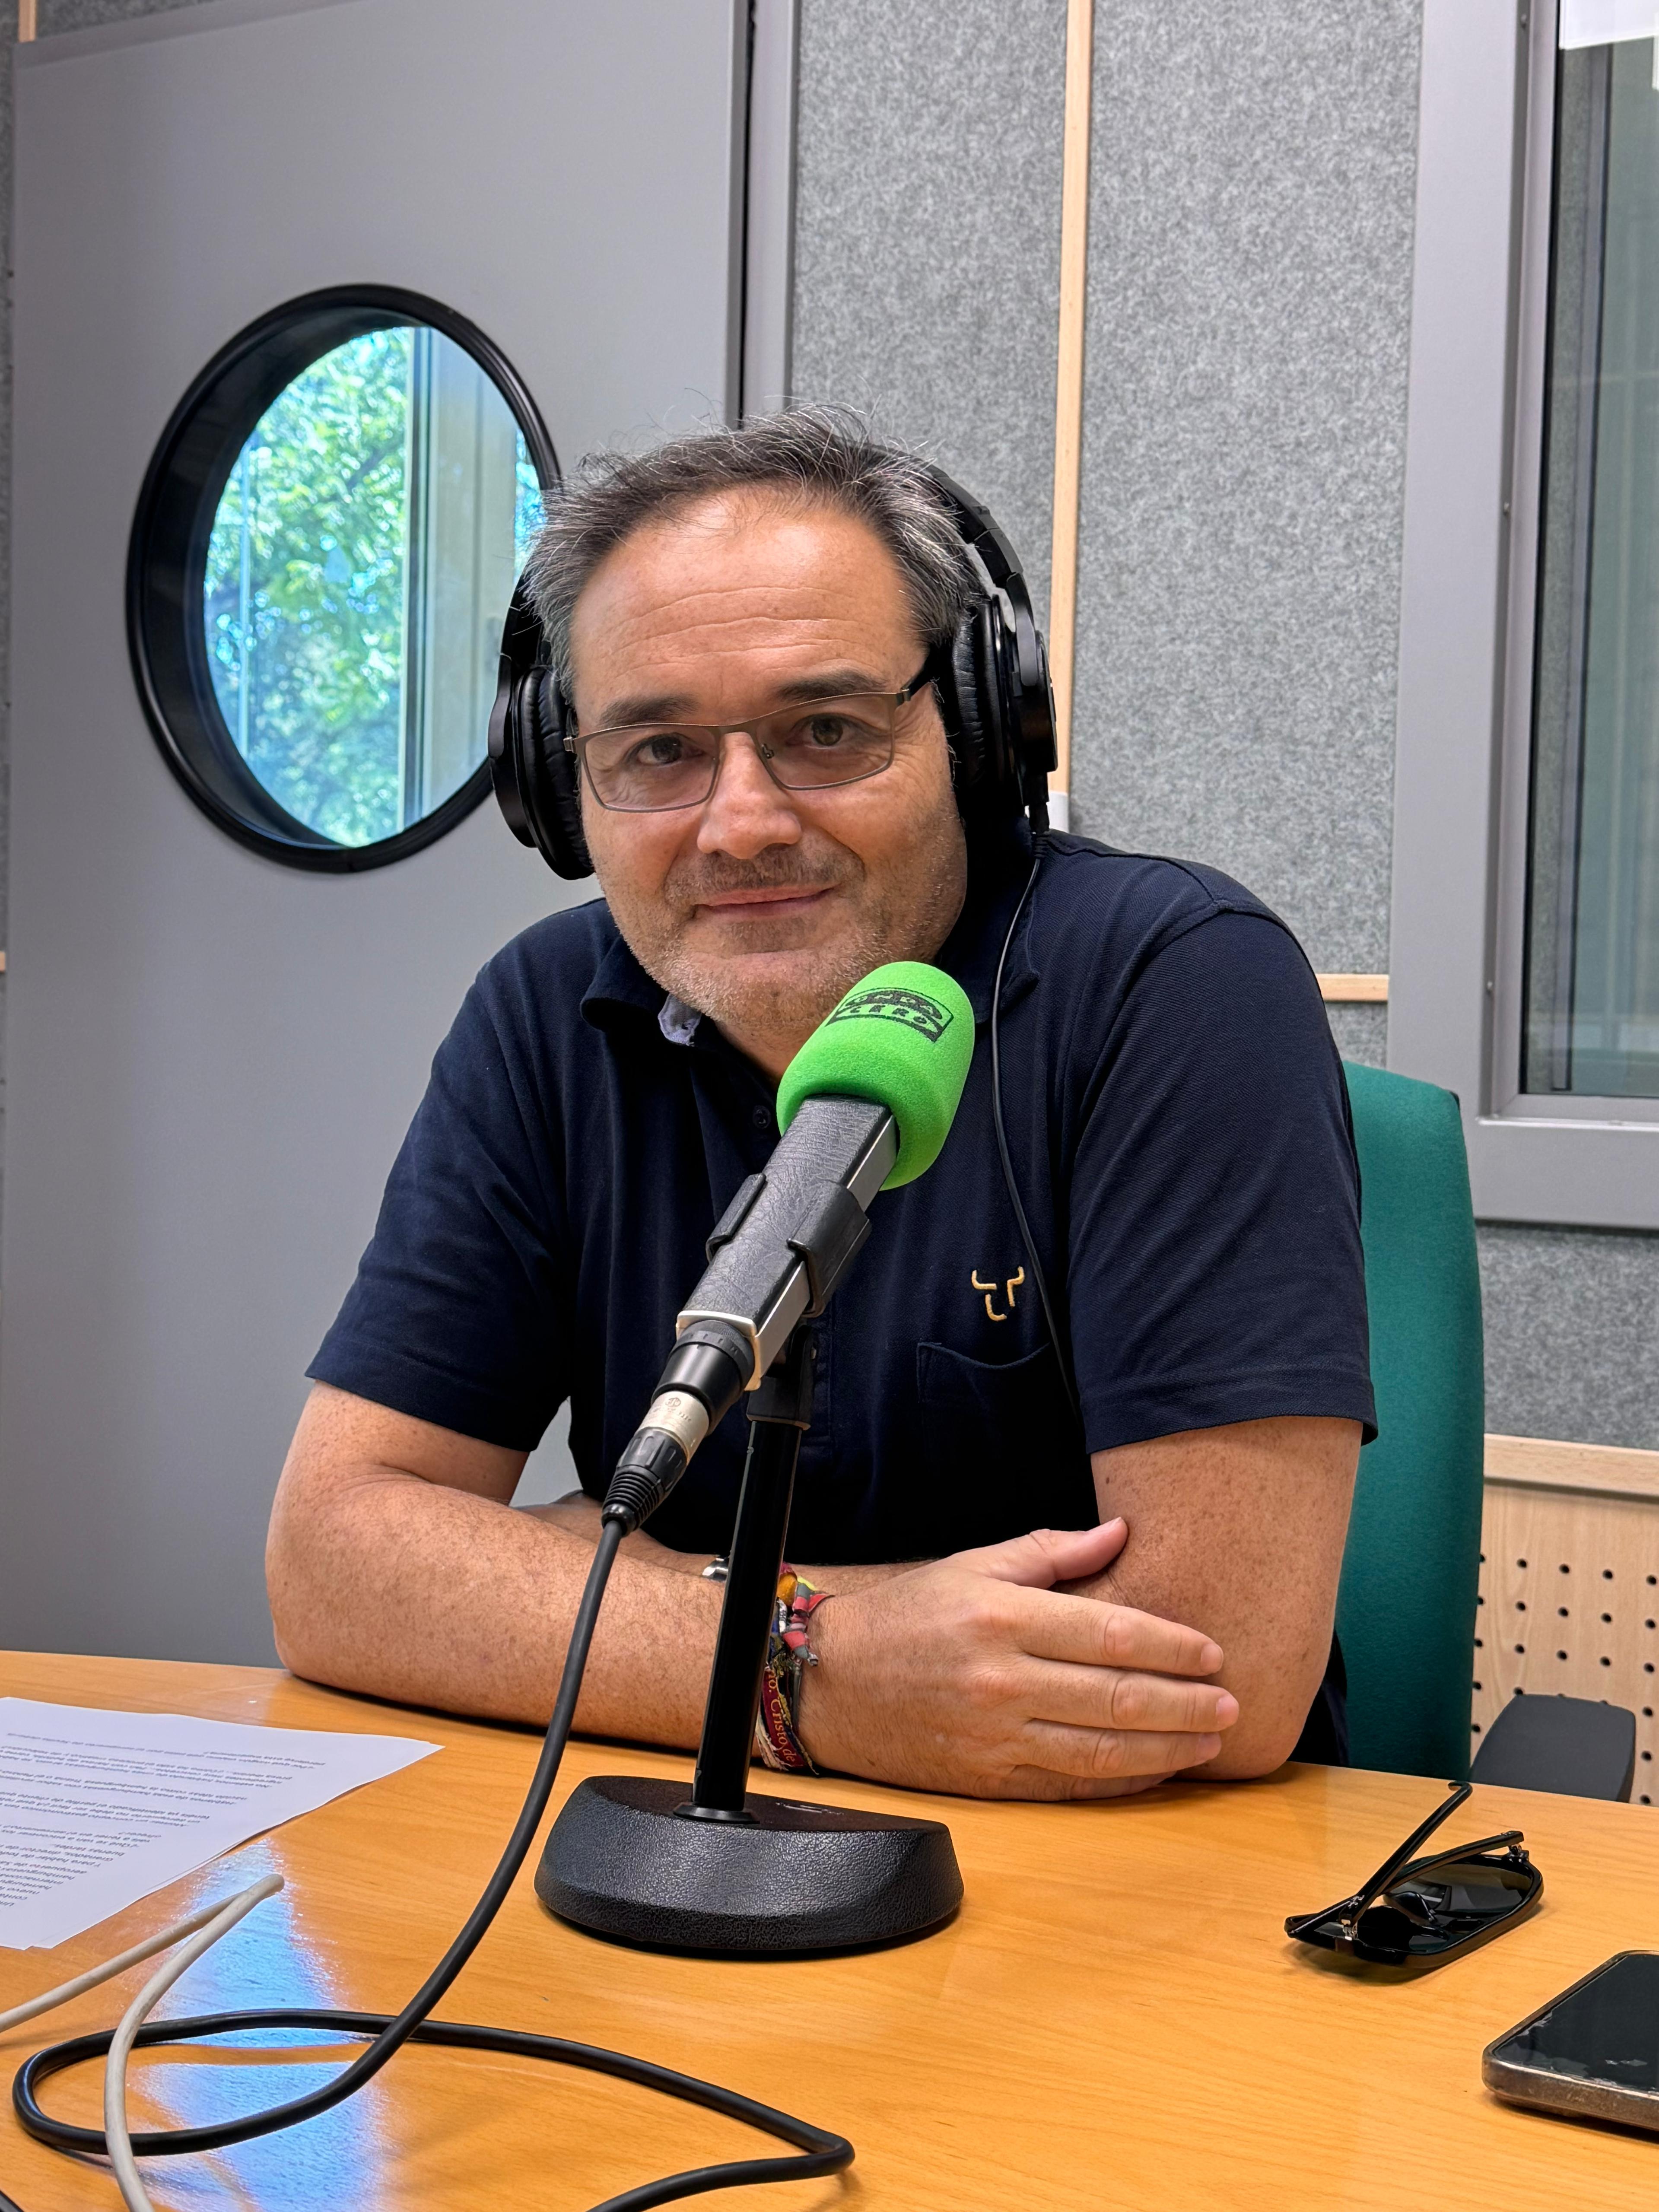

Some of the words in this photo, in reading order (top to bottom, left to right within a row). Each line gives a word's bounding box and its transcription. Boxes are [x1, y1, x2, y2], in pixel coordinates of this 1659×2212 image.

[853, 993, 934, 1014] ONDA
[850, 1004, 927, 1024] CERO
[770, 1698, 788, 1745] Cristo
[782, 1748, 796, 1762] de
[88, 1848, 125, 1856] buenas
[29, 1864, 87, 1874] aeropuerto
